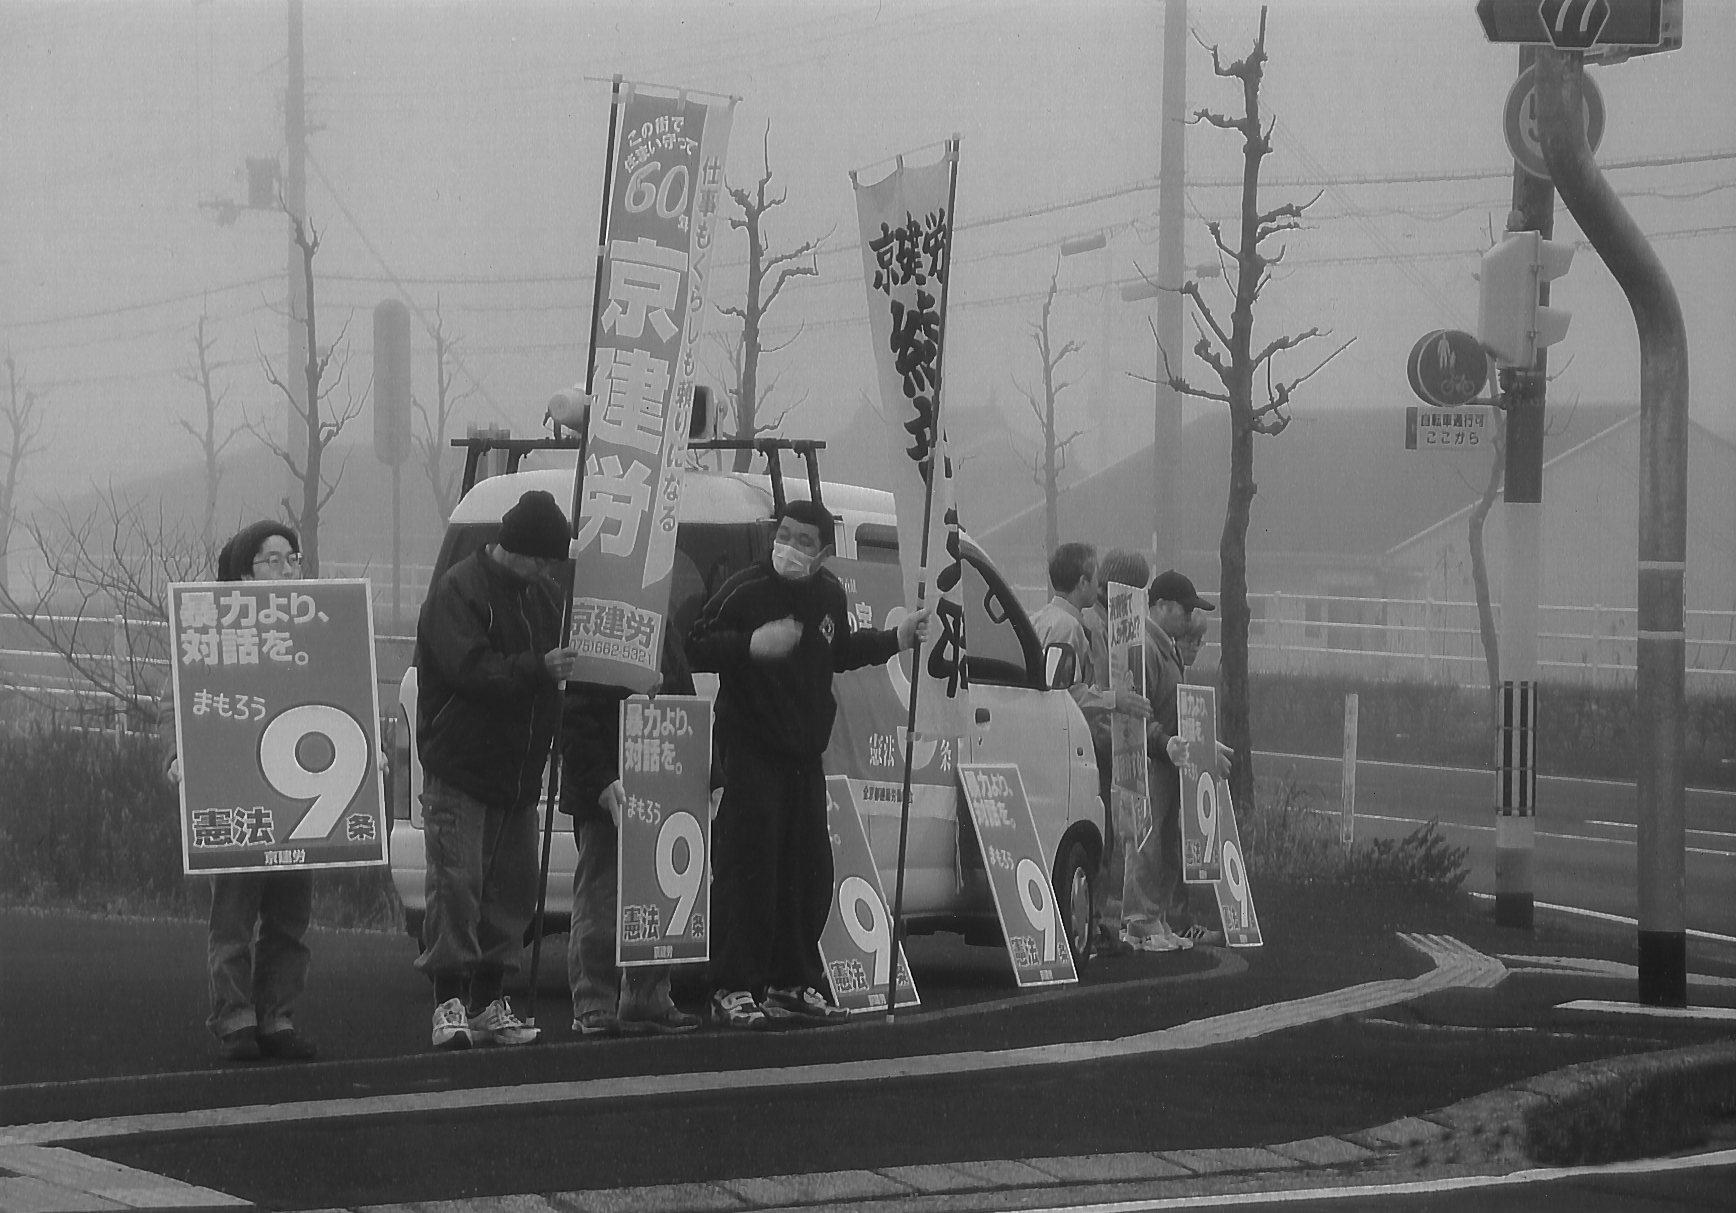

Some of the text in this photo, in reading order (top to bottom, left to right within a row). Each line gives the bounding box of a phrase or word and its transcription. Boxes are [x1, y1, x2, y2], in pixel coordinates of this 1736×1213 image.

[627, 115, 685, 147] この街で
[869, 208, 947, 297] 京建労
[578, 236, 689, 557] 京建労
[1420, 413, 1485, 428] 自転車通行可
[1426, 431, 1480, 445] ここから
[179, 590, 329, 628] 暴力より、
[570, 602, 655, 649] 京建労
[180, 627, 310, 665] 対話を。
[192, 688, 267, 721] まもろう
[625, 703, 693, 737] 暴力より、
[624, 737, 683, 775] 対話を。
[869, 733, 952, 772] 憲法 条
[191, 704, 377, 848] 憲法 9 条
[627, 794, 661, 825] まもろう
[1196, 771, 1217, 864] 9
[623, 811, 705, 941] 憲法 9 条
[988, 845, 1014, 870] まもろう
[1222, 840, 1248, 928] 9
[1016, 858, 1056, 962] 9
[839, 876, 891, 986] 9
[829, 958, 870, 993] 憲法
